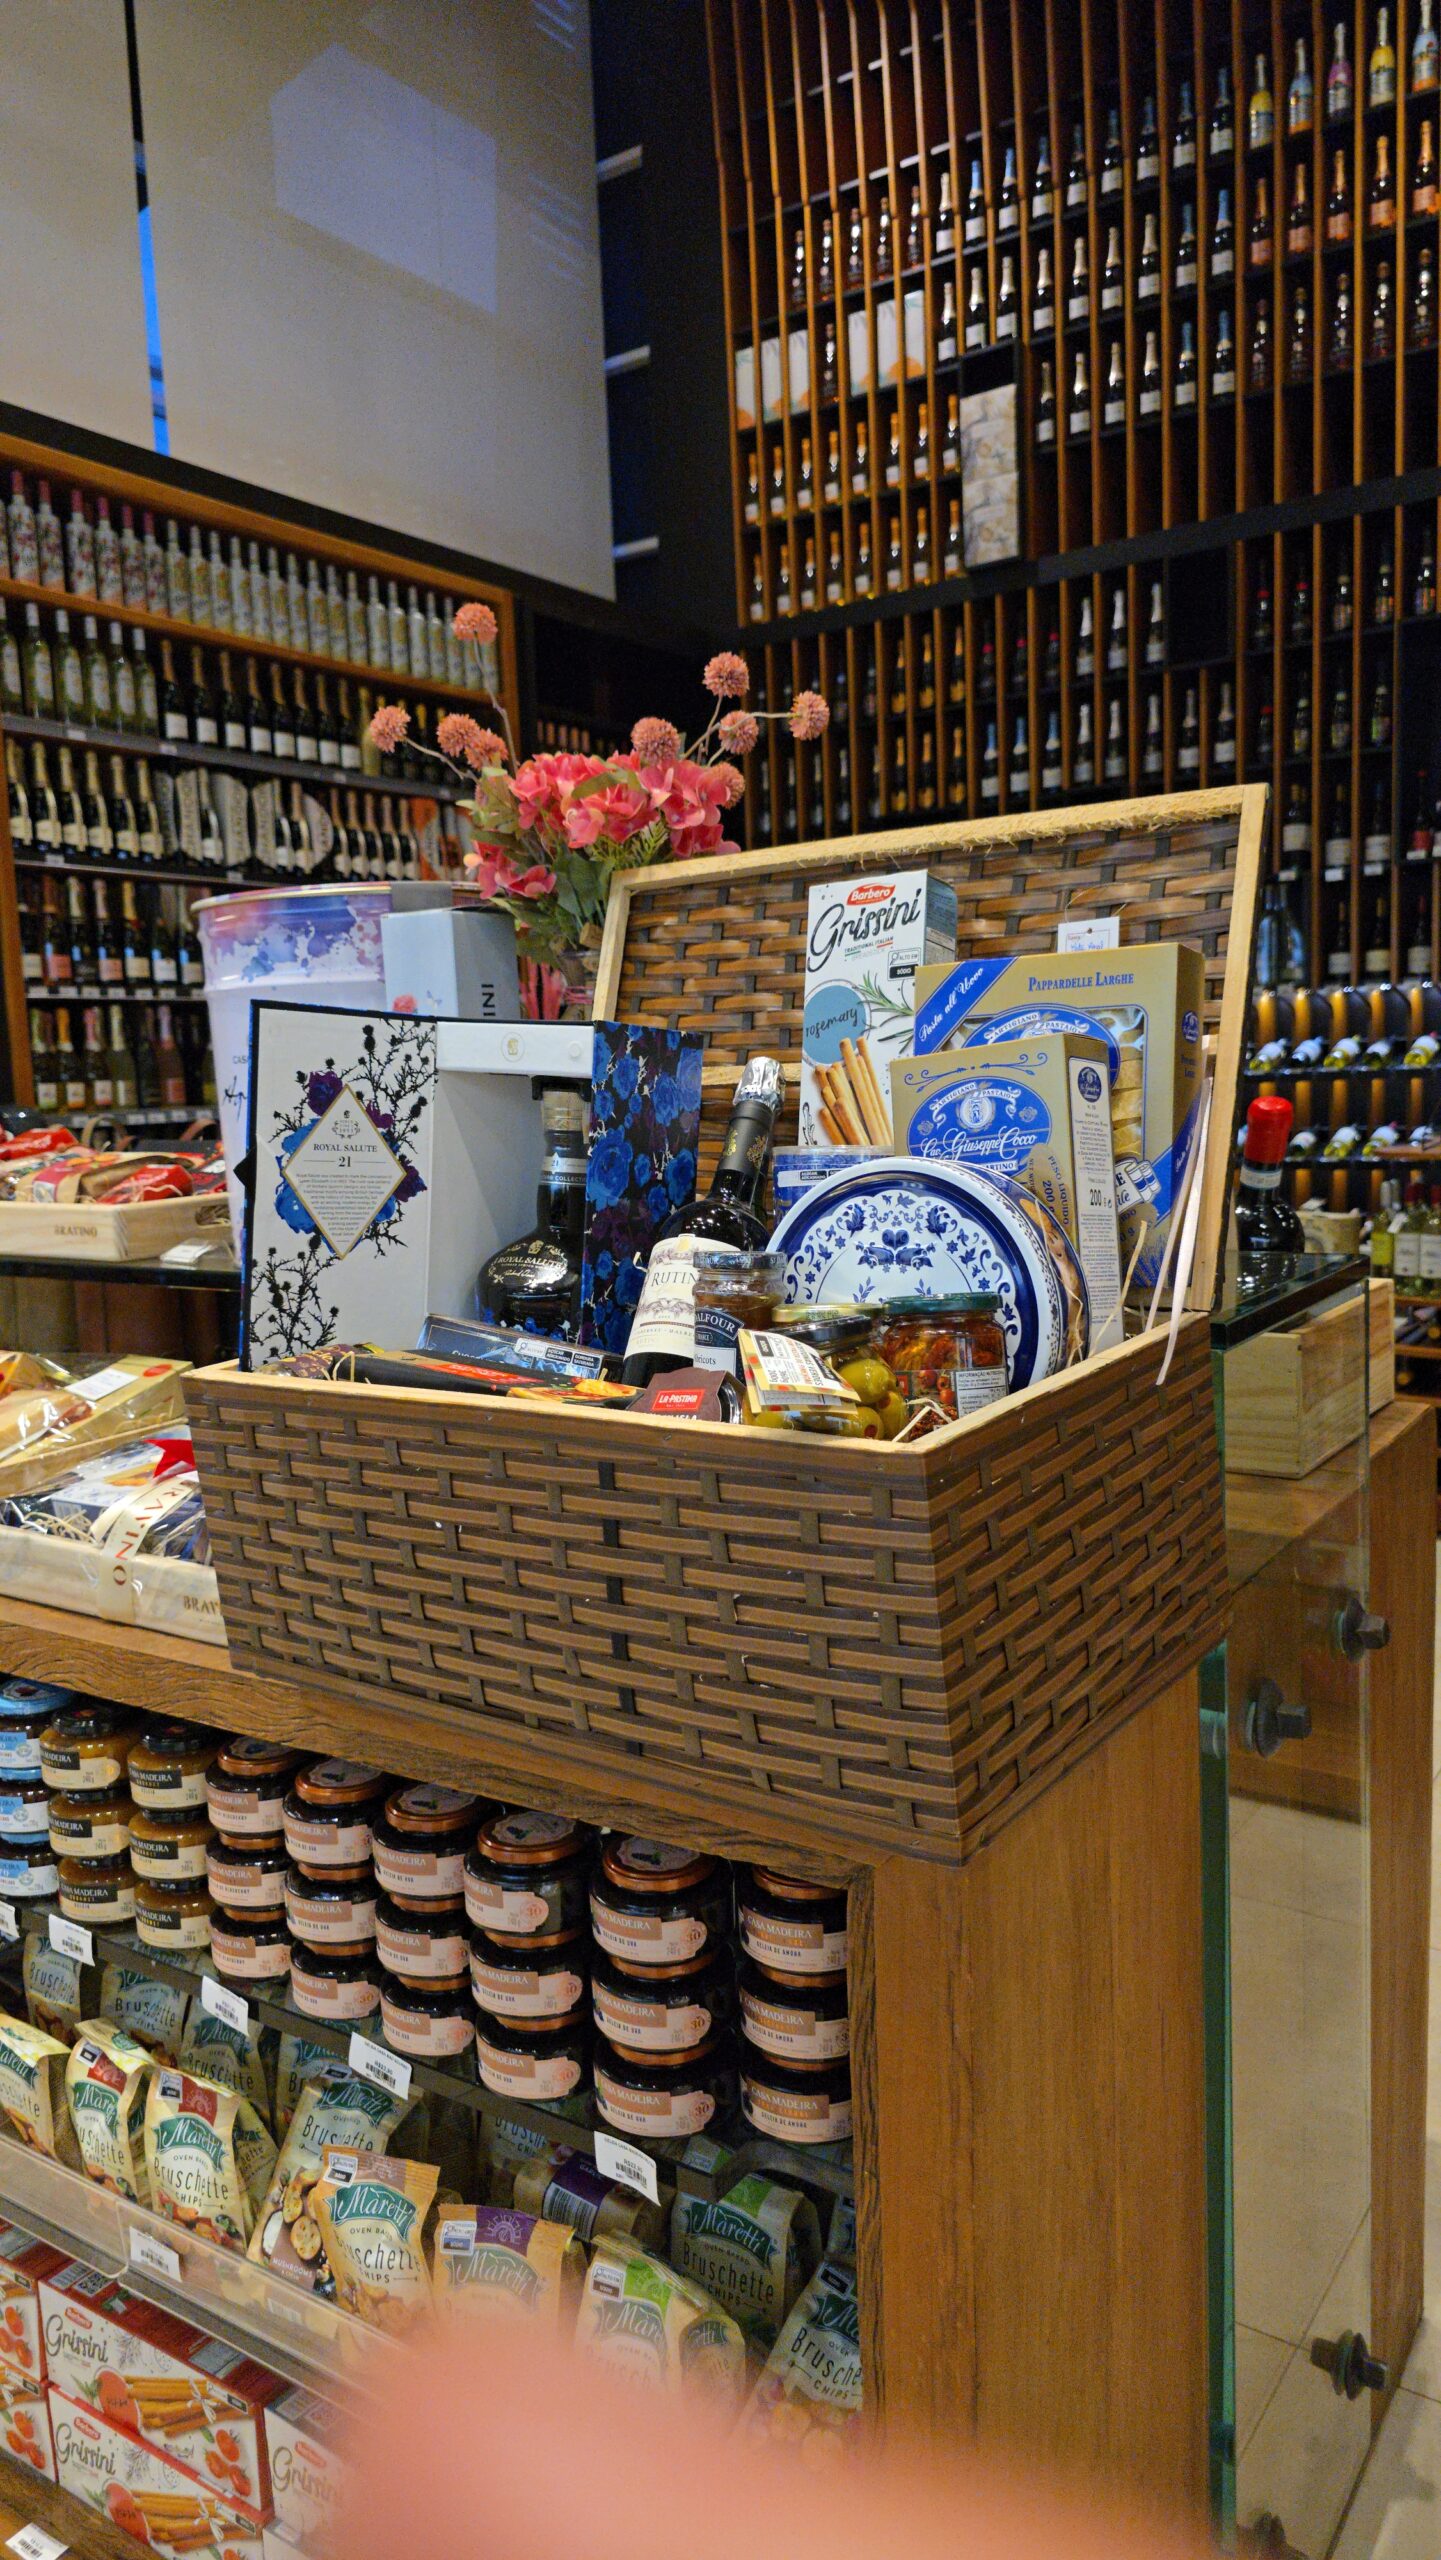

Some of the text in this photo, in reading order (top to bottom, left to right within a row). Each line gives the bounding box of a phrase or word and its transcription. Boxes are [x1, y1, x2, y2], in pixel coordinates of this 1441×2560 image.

[851, 887, 891, 901] Barbero
[807, 888, 922, 973] Grissini
[1028, 971, 1135, 992] PAPPARDELLE LARGHE
[805, 1007, 858, 1039] rosemary
[918, 1011, 944, 1042] Pasta
[993, 1013, 1079, 1040] ARTIGIANO PASTAIO
[233, 1055, 249, 1064] CAS
[936, 1083, 1011, 1108] ARTIGIANO PASTAIO
[313, 1143, 378, 1153] ROYAL SALUTE
[996, 1126, 1038, 1160] Cocco
[338, 1156, 352, 1168] 21
[984, 1161, 1014, 1172] ARTINO
[1042, 1180, 1054, 1203] 200
[1048, 1155, 1070, 1226] PESO LIQUIDO
[1089, 1188, 1102, 1206] 200
[651, 1271, 697, 1287] RUTIN
[669, 1329, 693, 1337] MALBE
[140, 1771, 172, 1782] MADEIRA
[138, 1841, 169, 1852] MADEIRA
[388, 1854, 426, 1866] MADEIRA
[74, 1886, 108, 1896] MADEIRA
[141, 1911, 172, 1922] MADEIRA
[304, 1902, 342, 1913] MADEIRA
[609, 1915, 651, 1930] MADEIRA
[748, 1915, 812, 1938] CASA MADEIRA
[385, 1932, 421, 1946] MADEIRA
[489, 1970, 528, 1985] MADEIRA
[612, 1999, 656, 2017] MADEIRA
[744, 1997, 804, 2025] CASA MADEIRA
[0, 2049, 30, 2077] aretti
[617, 2088, 661, 2105] MADEIRA
[751, 2086, 818, 2110] CASA MADEIRA
[163, 2118, 220, 2157] Maretti
[154, 2156, 229, 2200] Bruschette
[337, 2184, 413, 2229] Maretti
[693, 2205, 765, 2253] Maretti
[273, 2258, 313, 2278] MUSHROOMS
[683, 2241, 774, 2305] Bruschette
[46, 2314, 108, 2363] Grissini
[790, 2327, 863, 2386] Brusche
[814, 2379, 848, 2400] CHIPS
[56, 2422, 116, 2476] Grissini
